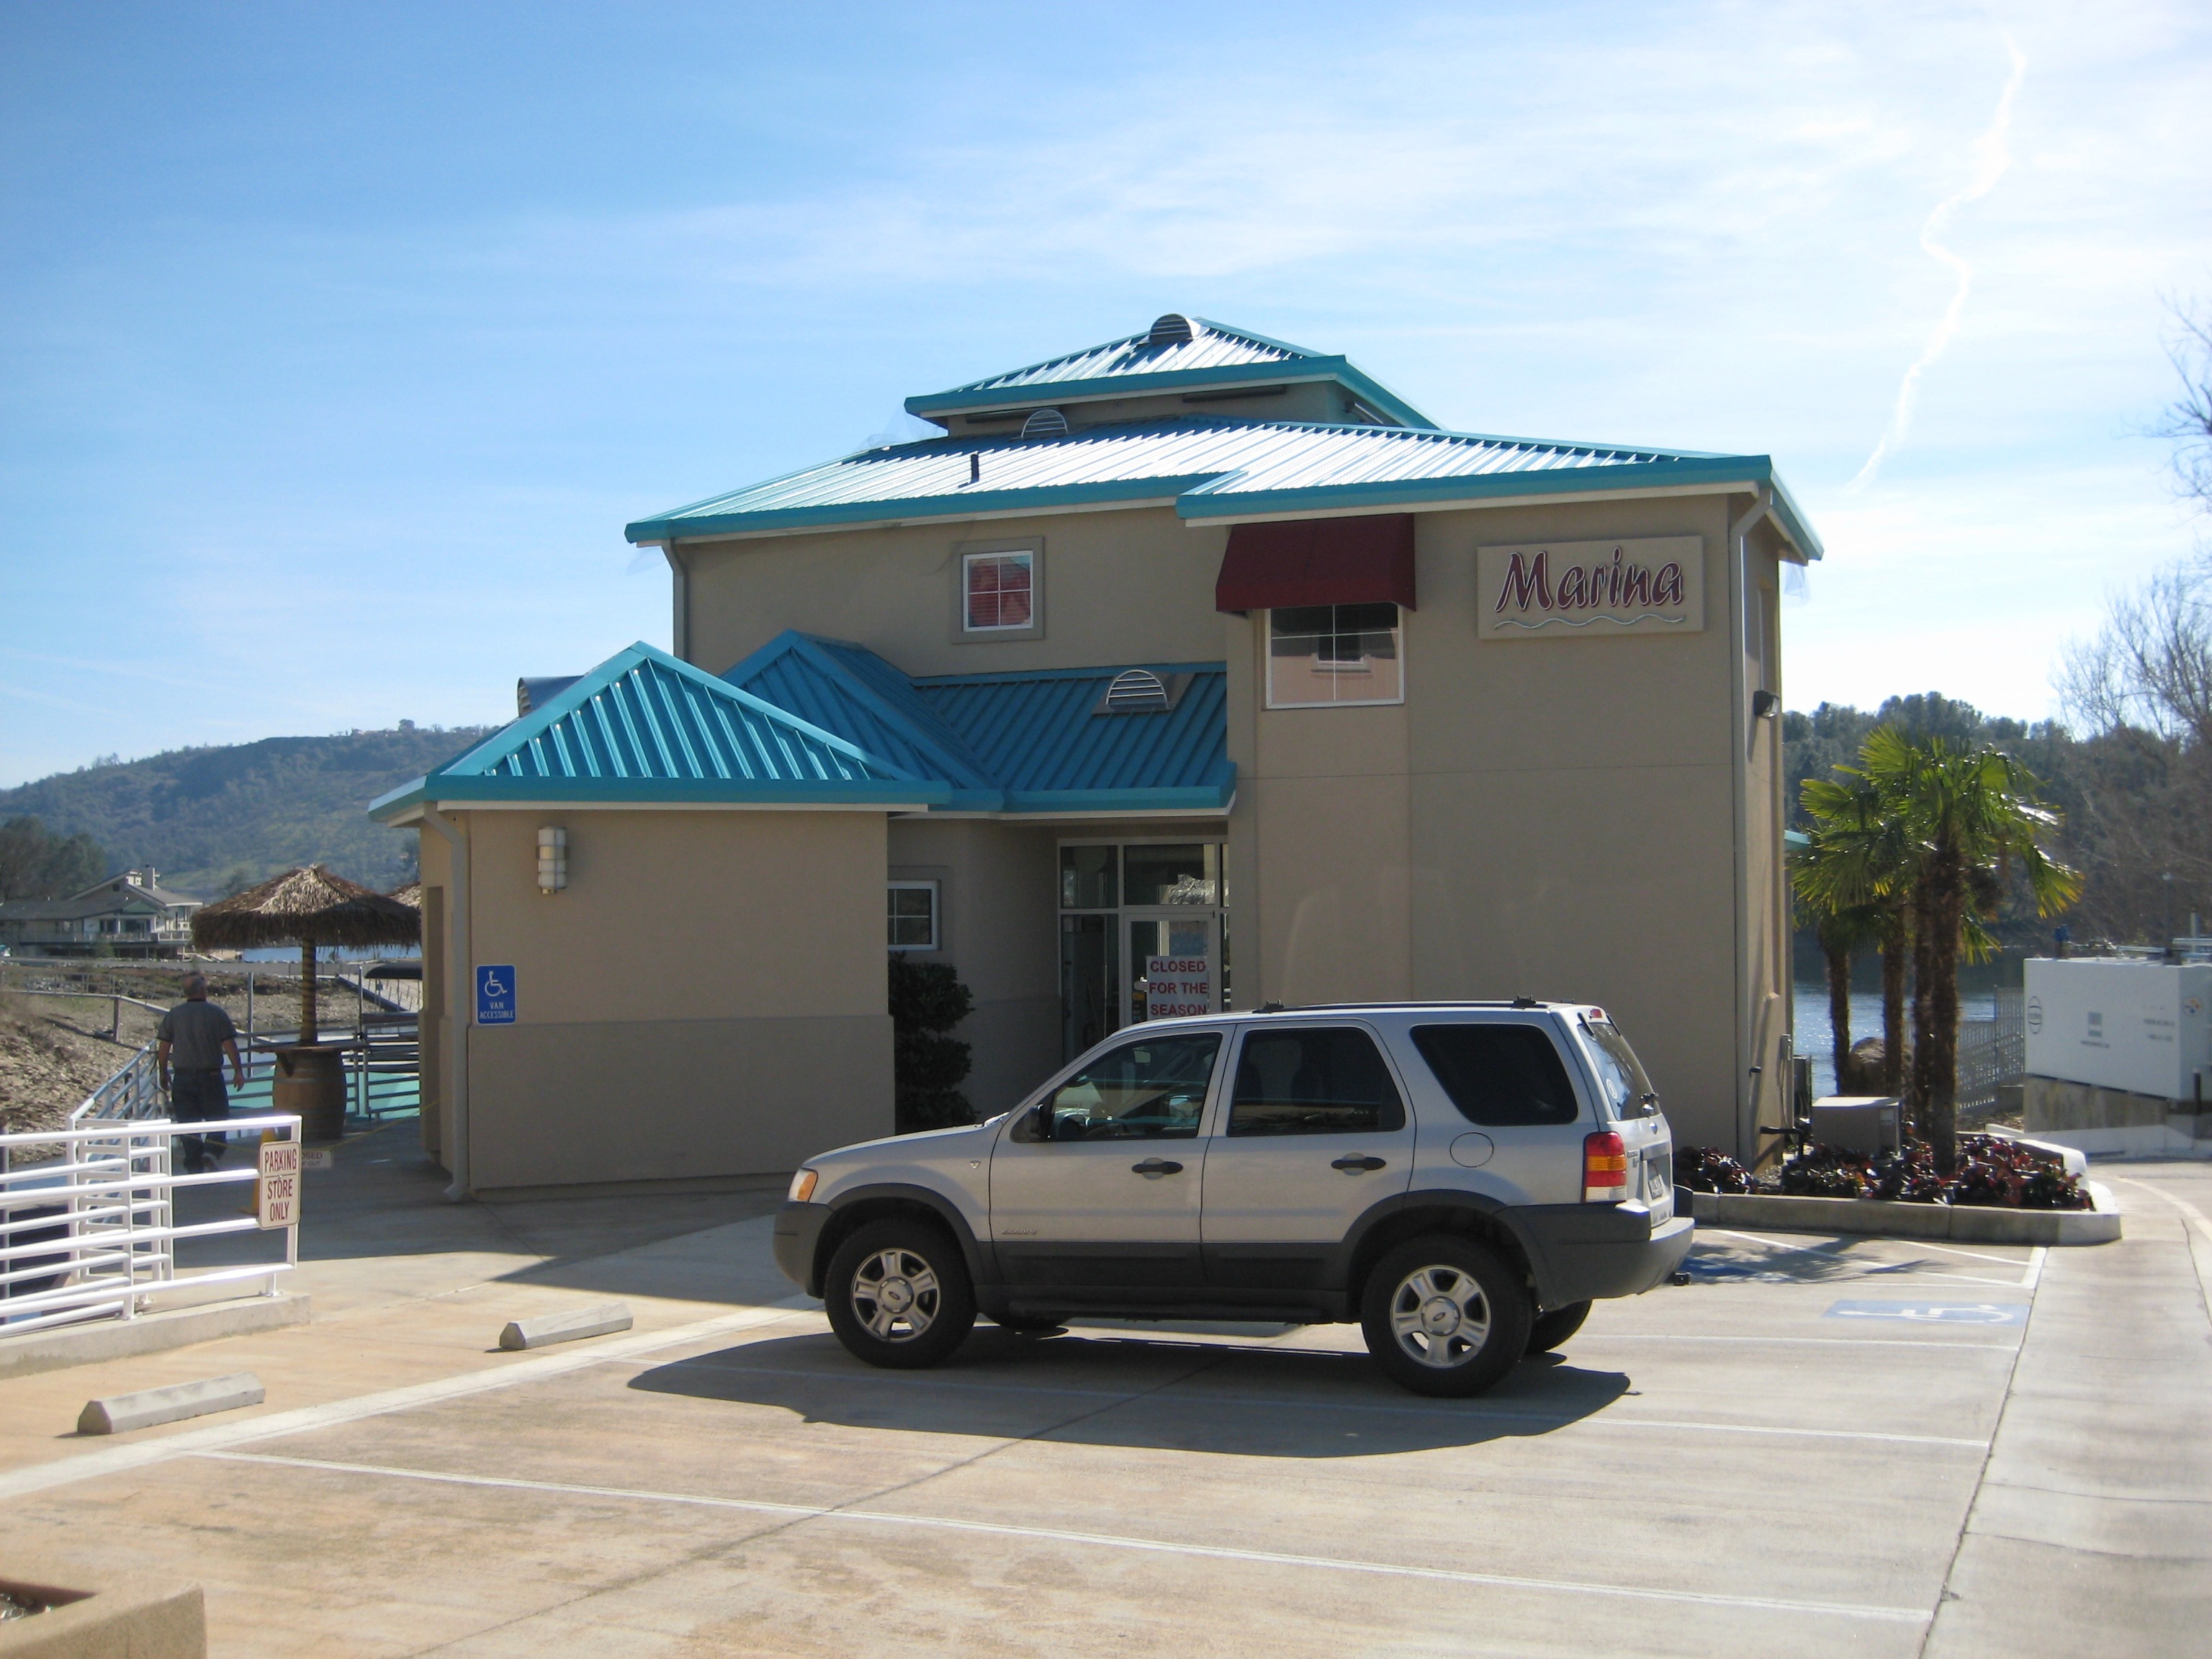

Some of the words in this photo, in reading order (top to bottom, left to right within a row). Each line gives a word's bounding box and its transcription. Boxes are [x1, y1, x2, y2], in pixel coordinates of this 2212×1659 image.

[1495, 547, 1683, 612] Marina
[1150, 961, 1206, 972] CLOSED
[1149, 982, 1177, 994] FOR
[1181, 982, 1208, 994] THE
[480, 1010, 513, 1019] ACCESSIBLE
[1151, 1004, 1206, 1017] SEASON
[264, 1148, 297, 1172] PARKING
[267, 1179, 292, 1200] STORE
[269, 1201, 289, 1221] ONLY
